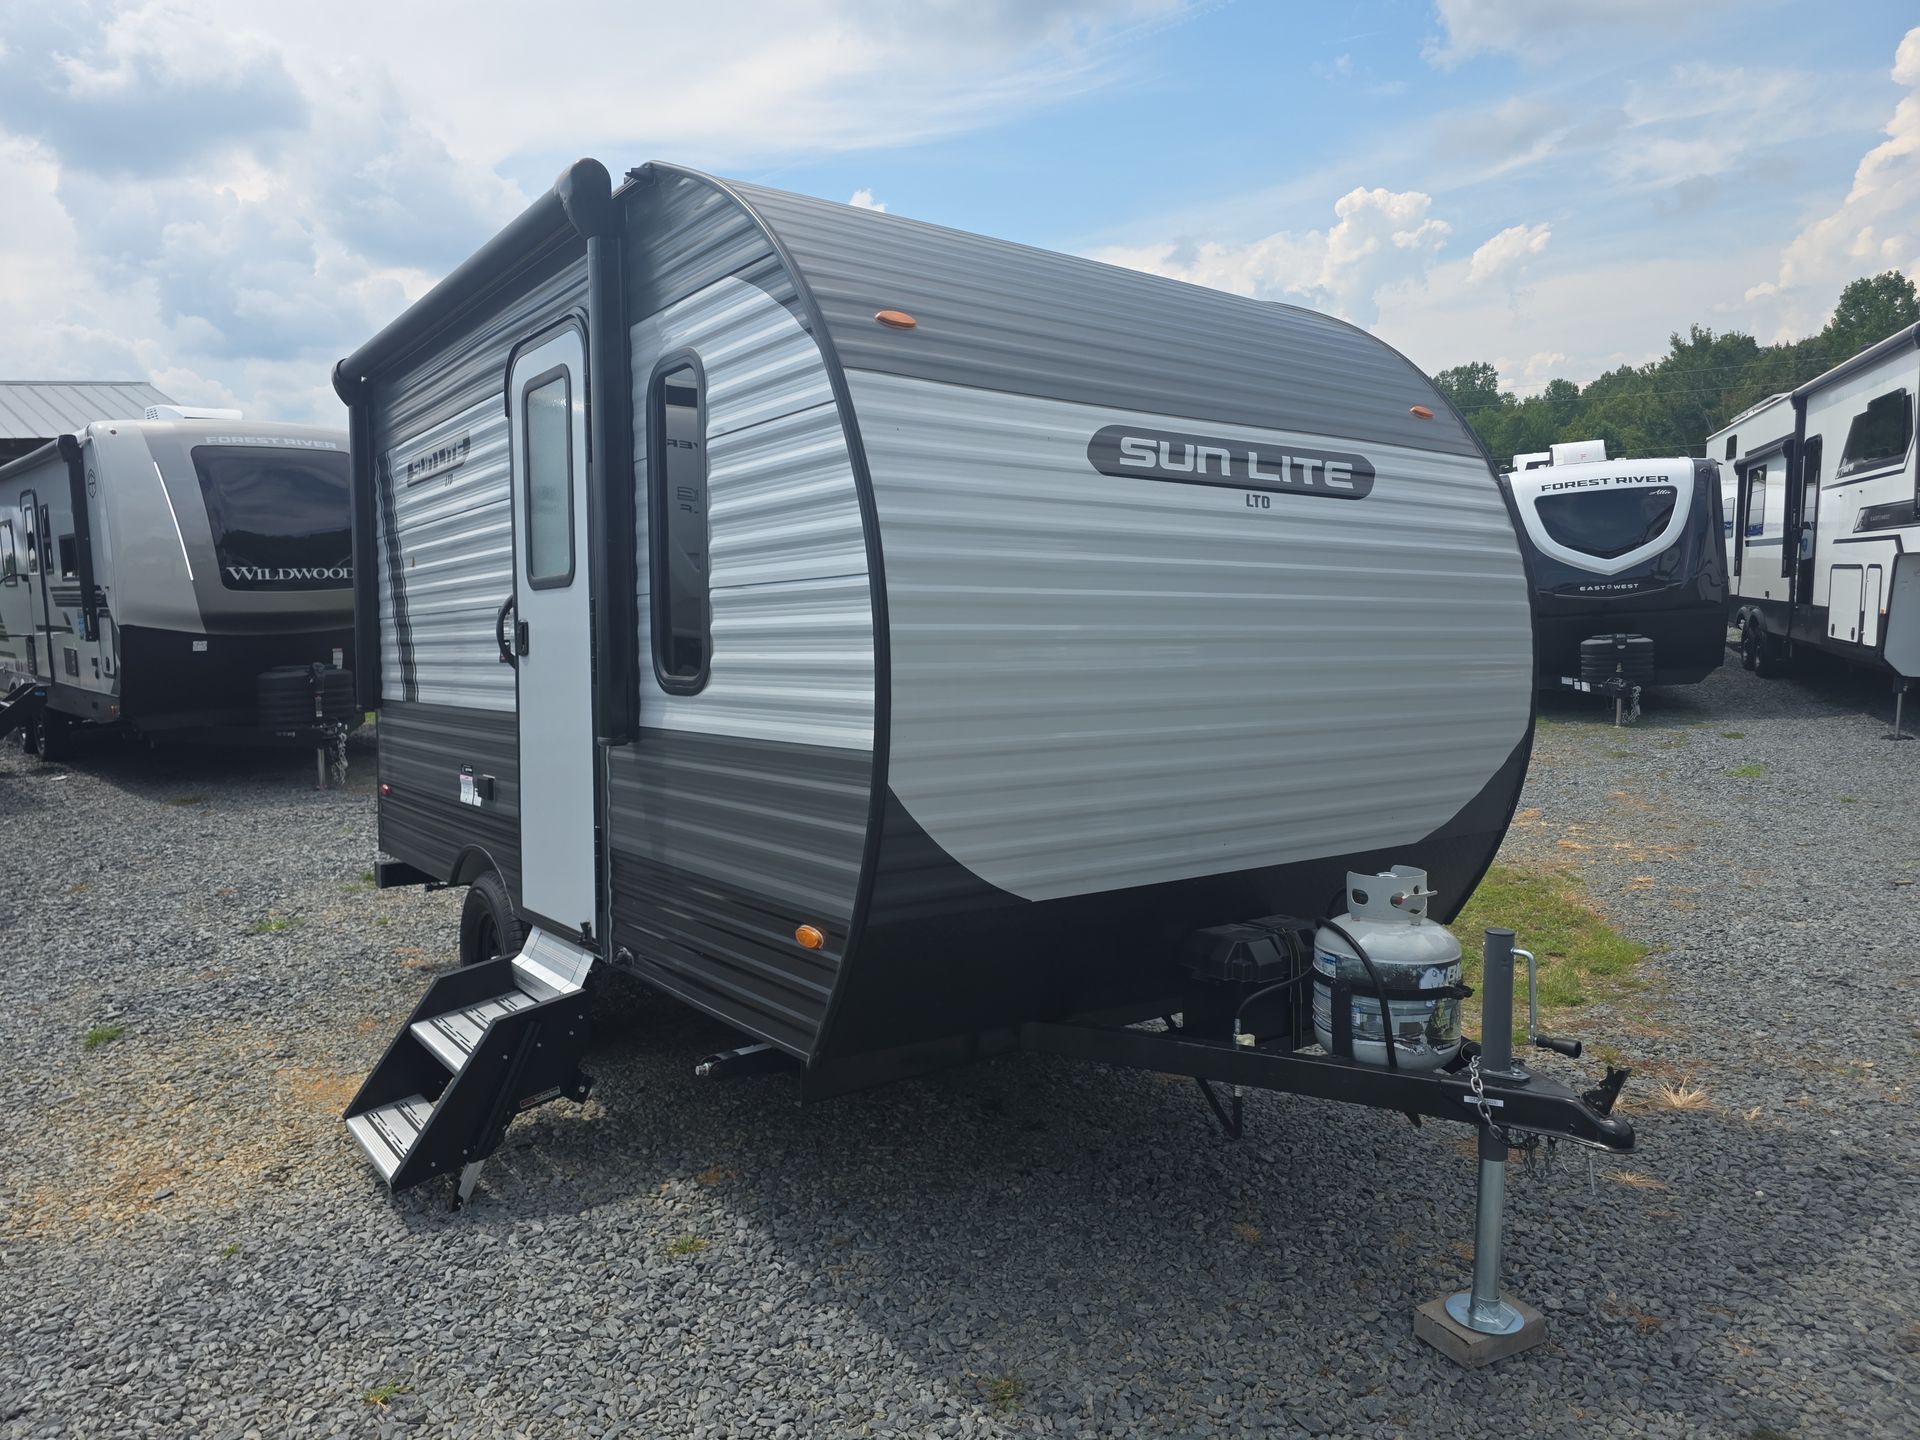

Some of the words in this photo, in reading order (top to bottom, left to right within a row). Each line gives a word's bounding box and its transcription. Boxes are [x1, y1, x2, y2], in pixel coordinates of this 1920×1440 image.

[205, 436, 279, 445] FOREST
[284, 438, 337, 449] RIVER
[1120, 436, 1231, 477] SUN
[1248, 451, 1354, 489] LITE
[1541, 478, 1611, 491] FOREST
[1616, 475, 1670, 484] RIVER
[1246, 493, 1271, 509] LTD
